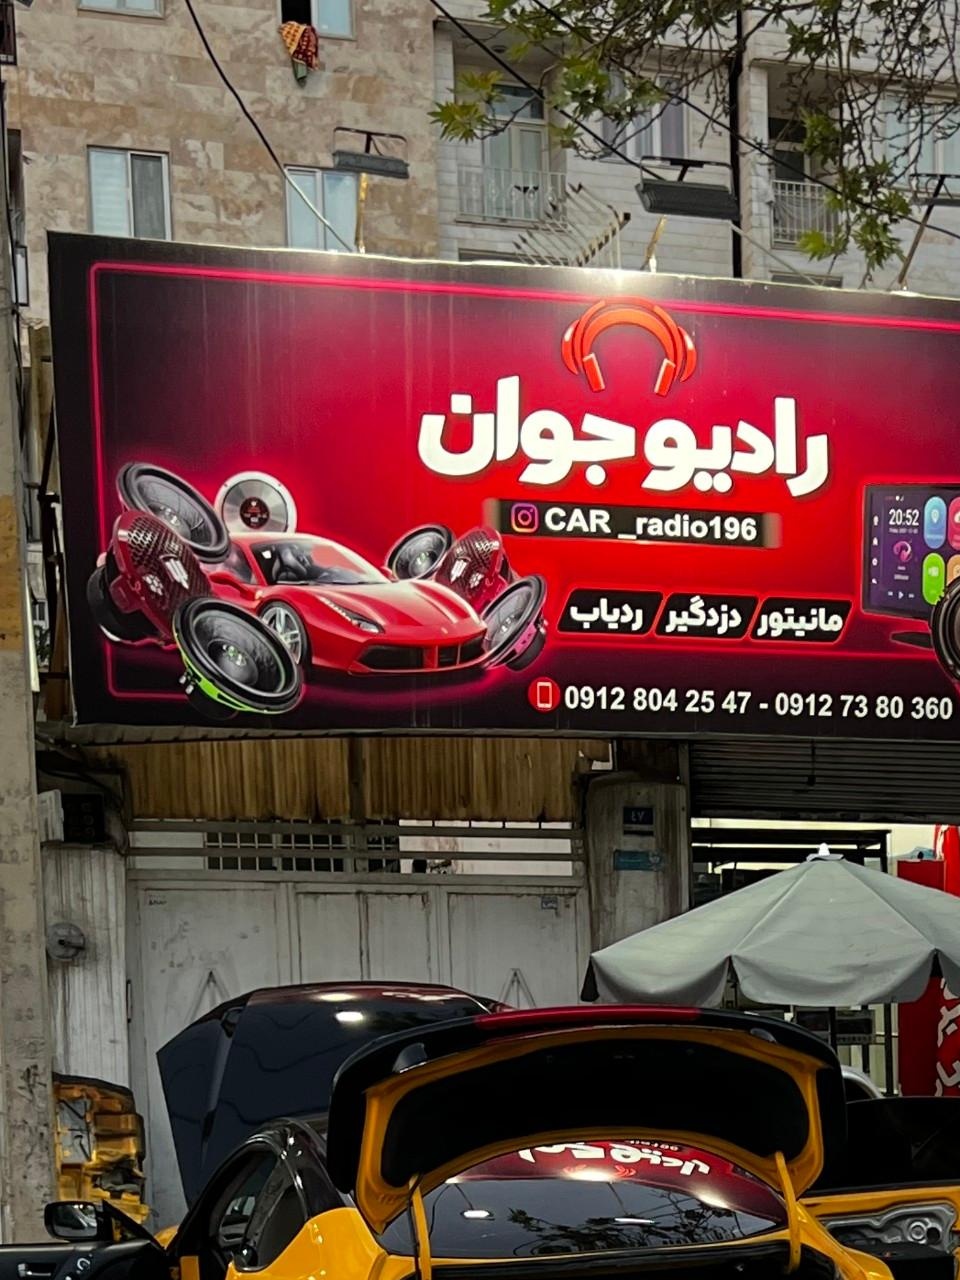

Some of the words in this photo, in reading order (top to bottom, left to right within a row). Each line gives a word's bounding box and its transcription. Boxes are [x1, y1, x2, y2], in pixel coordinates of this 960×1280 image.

[417, 375, 636, 486] جوان
[641, 397, 829, 497] رادیو
[545, 508, 611, 533] CAR
[617, 514, 757, 541] _radio196
[888, 508, 919, 526] 20:52
[569, 598, 644, 630] ردیاب
[665, 595, 742, 634] دزدگیر
[757, 607, 844, 637] مانیتور
[564, 685, 625, 711] 0912
[633, 687, 678, 712] 804
[685, 689, 715, 713] 25
[721, 691, 752, 715] 47
[775, 692, 833, 717] 0912
[840, 694, 869, 718] 73
[875, 696, 904, 719] 80
[911, 697, 953, 720] 360
